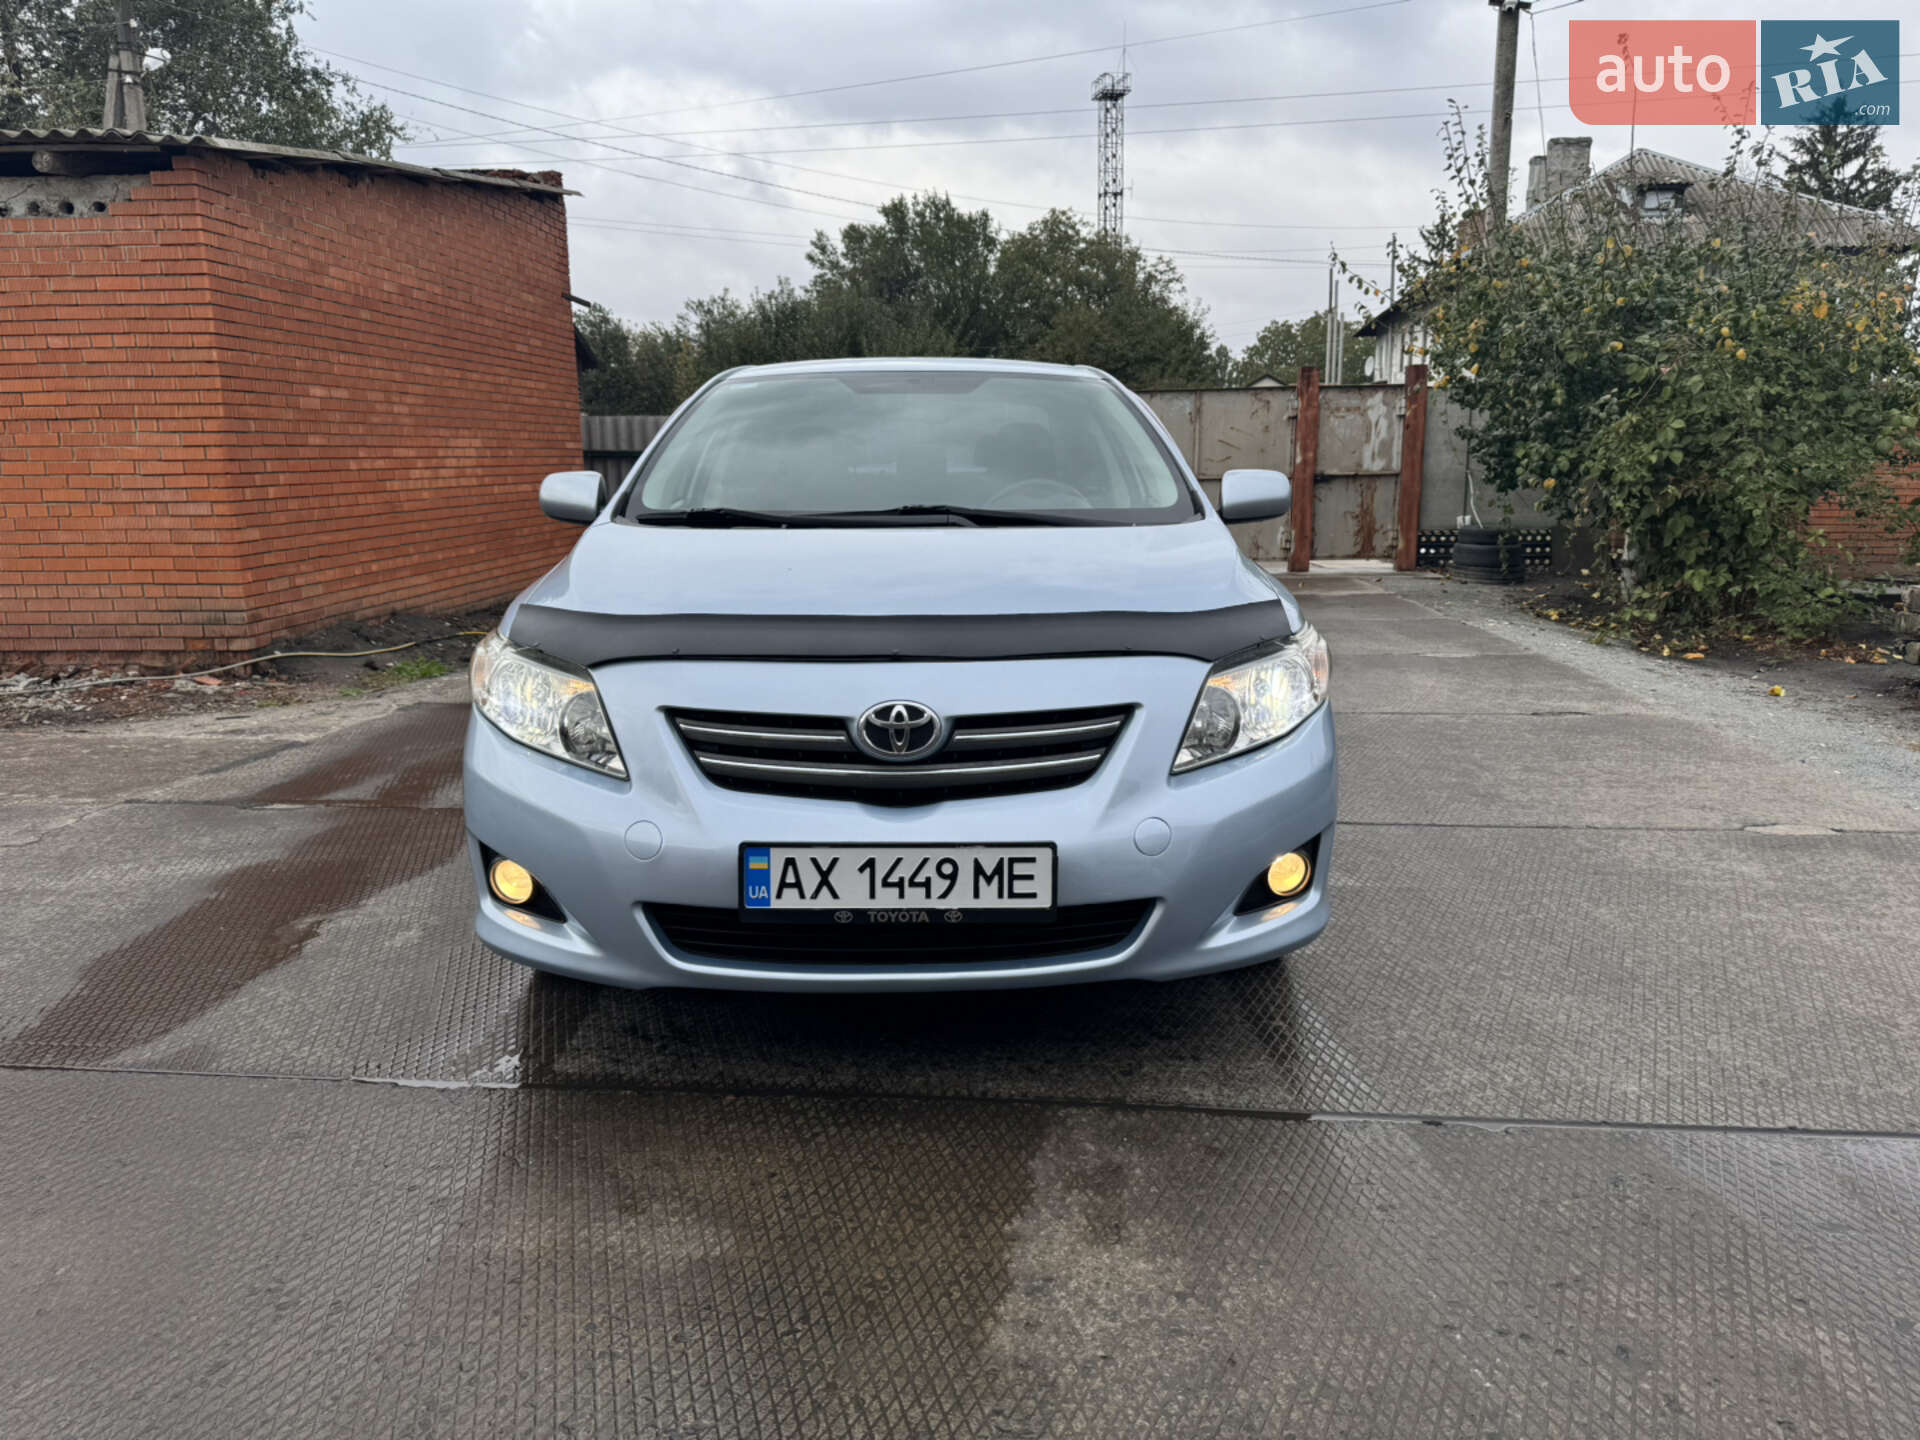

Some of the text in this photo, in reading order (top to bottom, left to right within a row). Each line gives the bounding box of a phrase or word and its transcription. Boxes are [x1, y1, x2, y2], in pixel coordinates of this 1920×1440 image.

[775, 857, 1037, 899] AX 1449 ME
[749, 886, 769, 899] UA
[867, 911, 929, 923] TOYOTA
